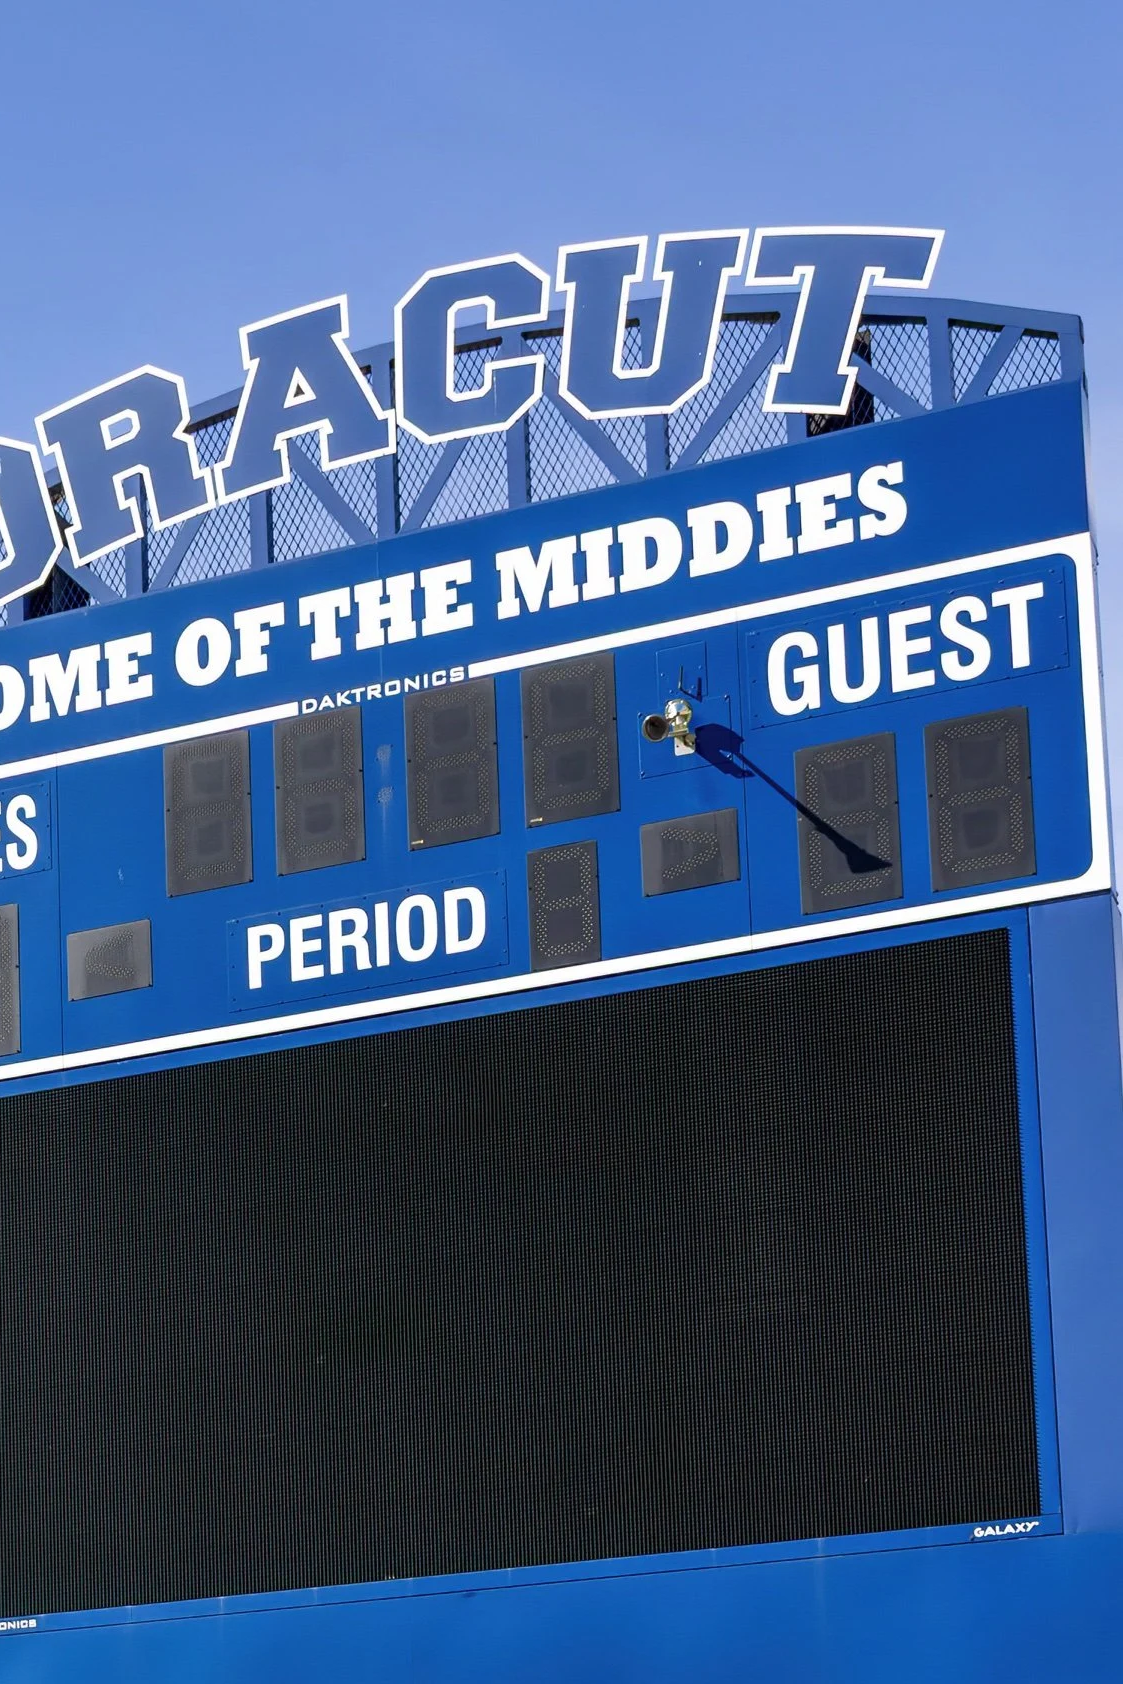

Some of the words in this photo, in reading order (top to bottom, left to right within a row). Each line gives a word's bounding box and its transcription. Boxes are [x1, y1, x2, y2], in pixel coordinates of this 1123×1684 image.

[175, 602, 285, 687] OF
[298, 558, 474, 661] THE
[495, 461, 907, 620] MIDDIES
[302, 666, 465, 715] DAKTRONICS
[766, 582, 1044, 716] GUEST
[247, 886, 486, 990] PERIOD
[973, 1521, 1040, 1538] GALAXY
